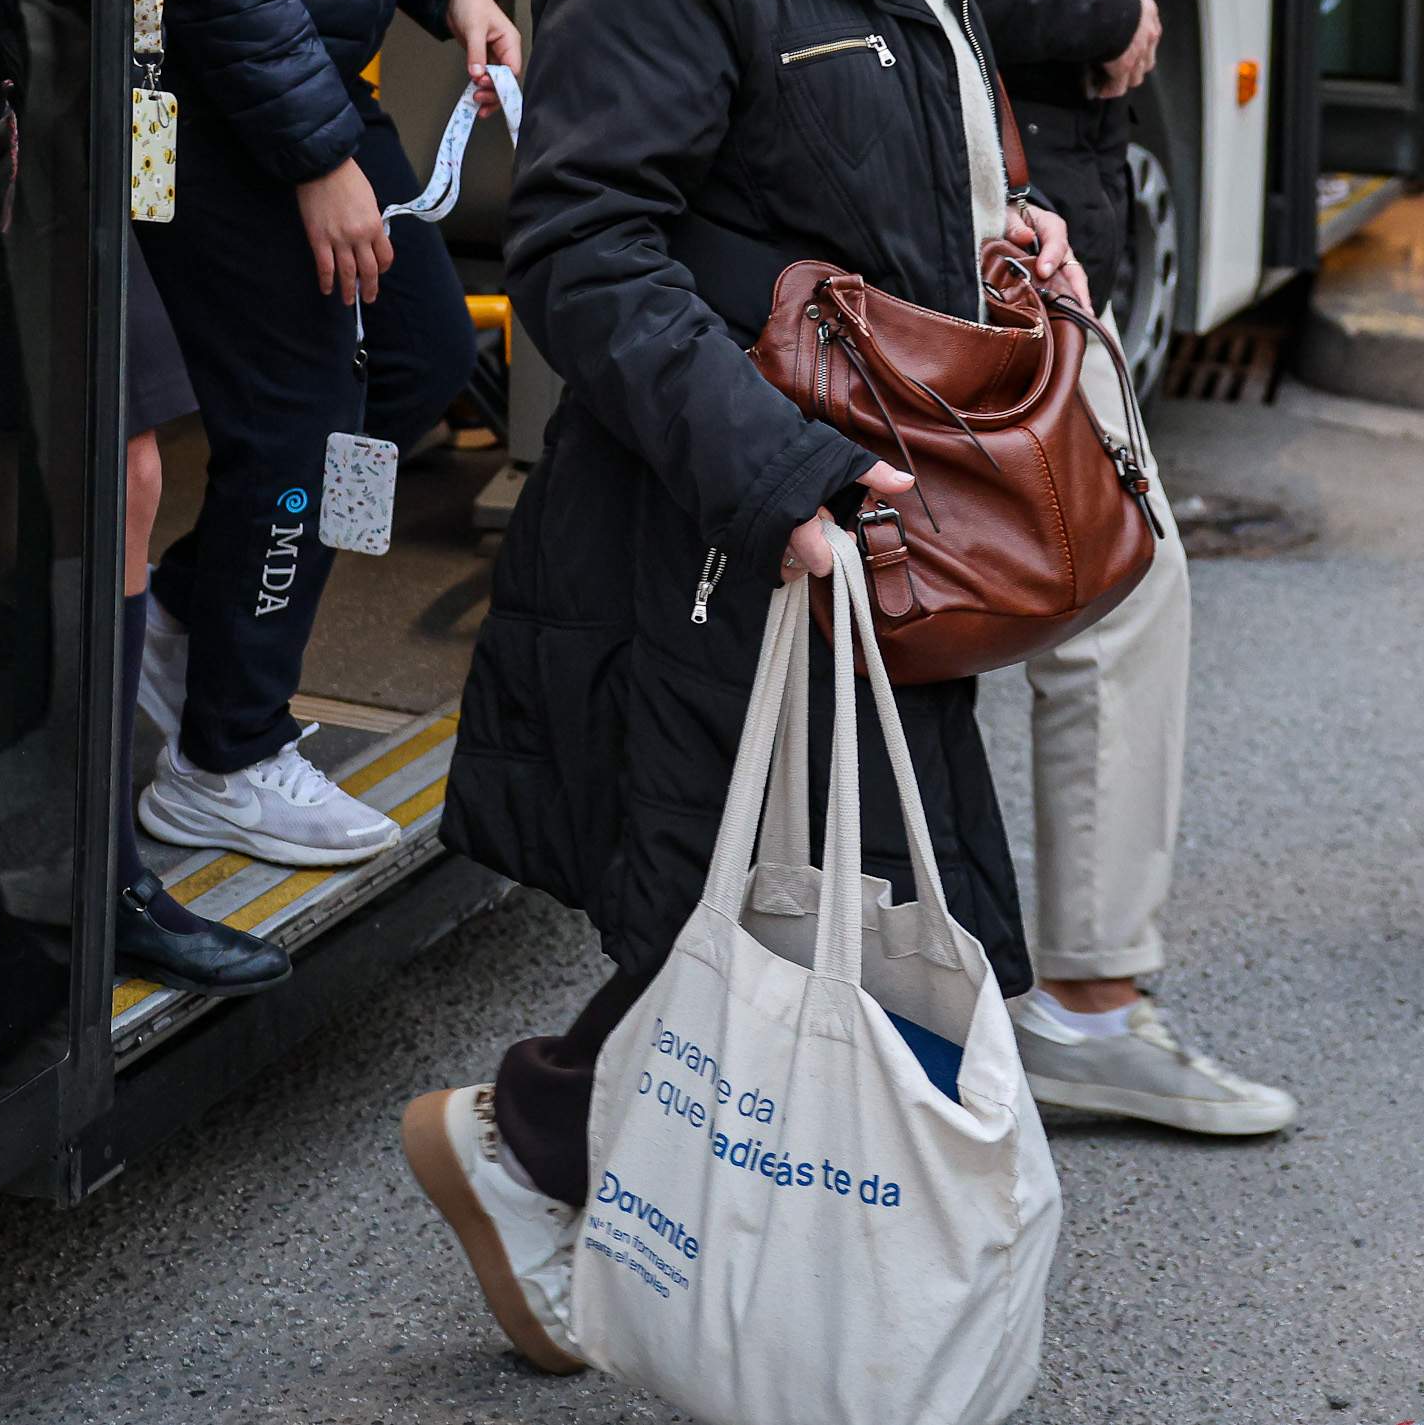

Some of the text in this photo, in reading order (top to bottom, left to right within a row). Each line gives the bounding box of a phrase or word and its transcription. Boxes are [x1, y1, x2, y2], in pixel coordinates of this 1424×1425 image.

[254, 522, 304, 618] MDA
[657, 1080, 706, 1128] que
[821, 1158, 851, 1195] te
[859, 1174, 901, 1208] da
[738, 1087, 775, 1125] da
[595, 1170, 700, 1260] Davante
